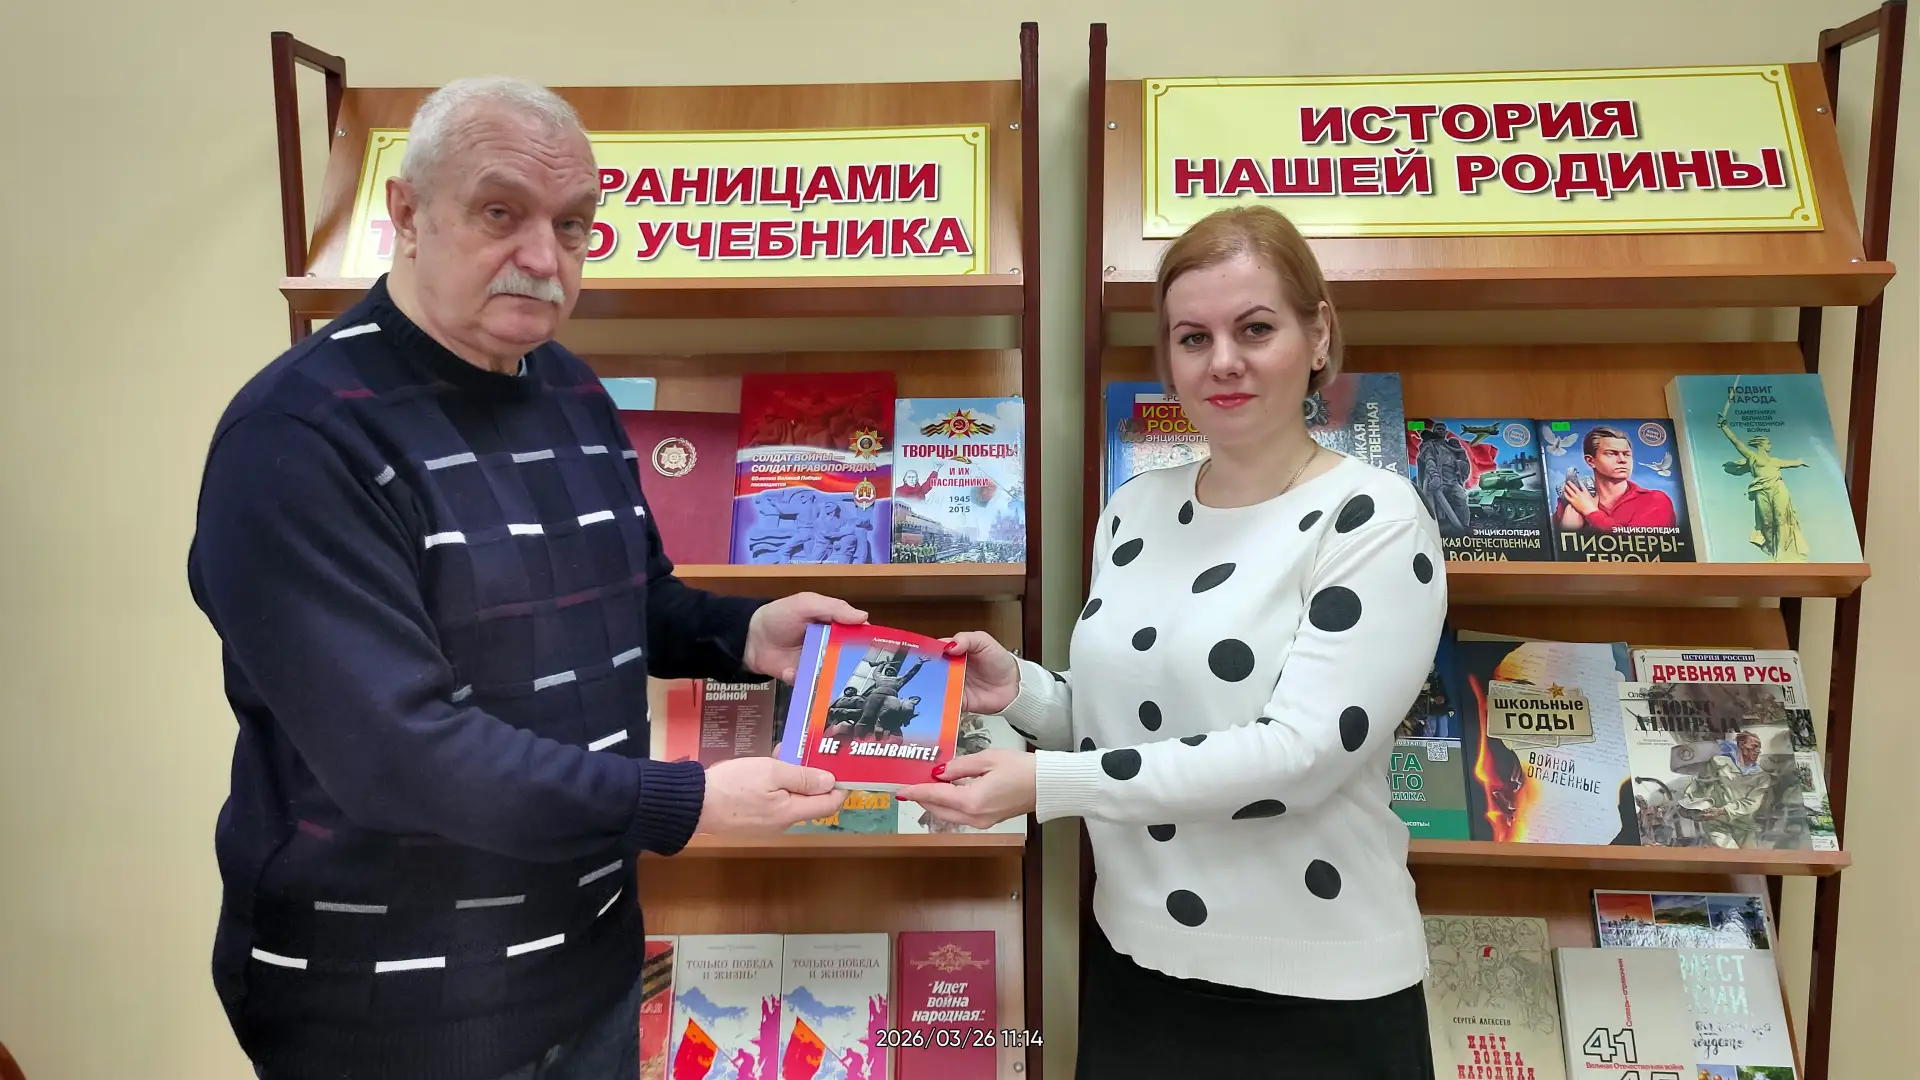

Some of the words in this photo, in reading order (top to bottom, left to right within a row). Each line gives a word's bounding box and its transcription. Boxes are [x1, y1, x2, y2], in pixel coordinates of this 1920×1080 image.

[1300, 101, 1638, 144] ИСТОРИЯ
[1173, 150, 1433, 197] НАШЕЙ
[1456, 148, 1786, 199] РОДИНЫ
[597, 163, 938, 208] РАНИЦАМИ
[636, 218, 970, 260] УЧЕБНИКА
[1727, 386, 1773, 395] ПОДВИГ
[1147, 420, 1199, 433] РОСС
[1145, 434, 1209, 443] ЭНЦИКЛОПЕ
[1367, 402, 1382, 469] СТВЕННАЯ
[752, 452, 792, 463] СОЛДАТ
[793, 451, 834, 462] ВОЙНЫ
[902, 444, 958, 459] ТВОРЦЫ
[962, 443, 1018, 459] ПОБЕДЫ
[751, 464, 792, 474] СОЛДАТ
[793, 463, 877, 473] ПРАВОПОРЯДКА
[949, 467, 956, 476] И
[958, 467, 970, 476] ИХ
[930, 478, 989, 488] НАСЛЕДНИКИ
[1612, 526, 1680, 534] ЭНЦИКЛОПЕДИЯ
[1463, 536, 1541, 549] ОТЕЧЕСТВЕННАЯ
[1560, 532, 1685, 553] ПИОНЕРЫ-
[1449, 549, 1509, 562] ВОЙНА
[1652, 664, 1737, 684] ДРЕВНЯЯ
[1743, 665, 1792, 683] РУСЬ
[706, 682, 770, 691] ОПАЛЕННЫЕ
[705, 690, 748, 700] ВОЙНОЙ
[1505, 712, 1575, 731] ГОДЫ
[818, 737, 840, 754] НЕ
[848, 740, 940, 761] ЗАБЫВАЙТЕ!
[1390, 752, 1423, 772] ГА
[1529, 751, 1576, 774] ВОЙНОЙ
[1391, 772, 1423, 791] ГО
[1527, 765, 1601, 794] ОПАЛЕННЫЕ
[1391, 791, 1427, 802] НИКА
[686, 959, 728, 969] ТОЛЬКО
[732, 958, 774, 969] ПОБЕДА
[791, 959, 834, 969] ТОЛЬКО
[838, 958, 880, 968] ПОБЕДА
[702, 971, 711, 980] И
[714, 970, 758, 980] ЖИЗНЬ!
[808, 970, 817, 980] И
[820, 969, 864, 979] ЖИЗНЬ!
[926, 995, 970, 1008] война
[1452, 1015, 1477, 1025] СЕРГЕЙ
[1479, 1017, 1512, 1026] АЛЕКСЕЕВ
[1467, 1033, 1506, 1051] ИДЁТ
[1583, 1027, 1638, 1063] 41
[1473, 1050, 1524, 1067] ВОЙНА
[1457, 1064, 1536, 1080] НАРОДНАЯ
[1665, 1063, 1684, 1071] война
